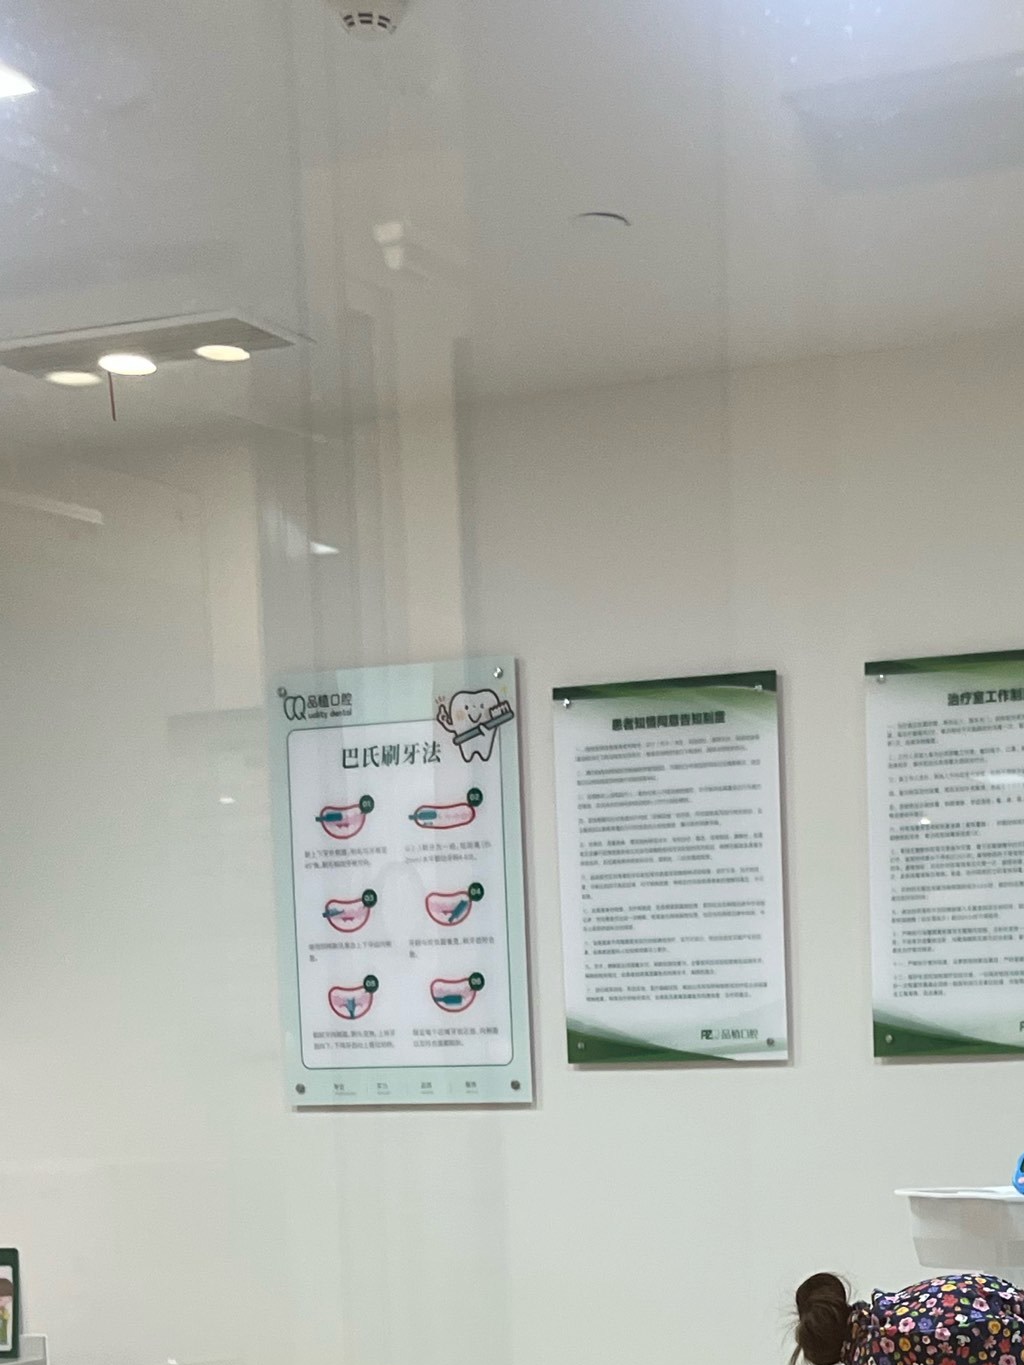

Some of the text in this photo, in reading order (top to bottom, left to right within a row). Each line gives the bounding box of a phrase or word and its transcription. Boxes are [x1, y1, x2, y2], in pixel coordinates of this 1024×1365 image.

[307, 692, 353, 709] 品植口腔
[342, 740, 442, 769] 巴氏刷牙法
